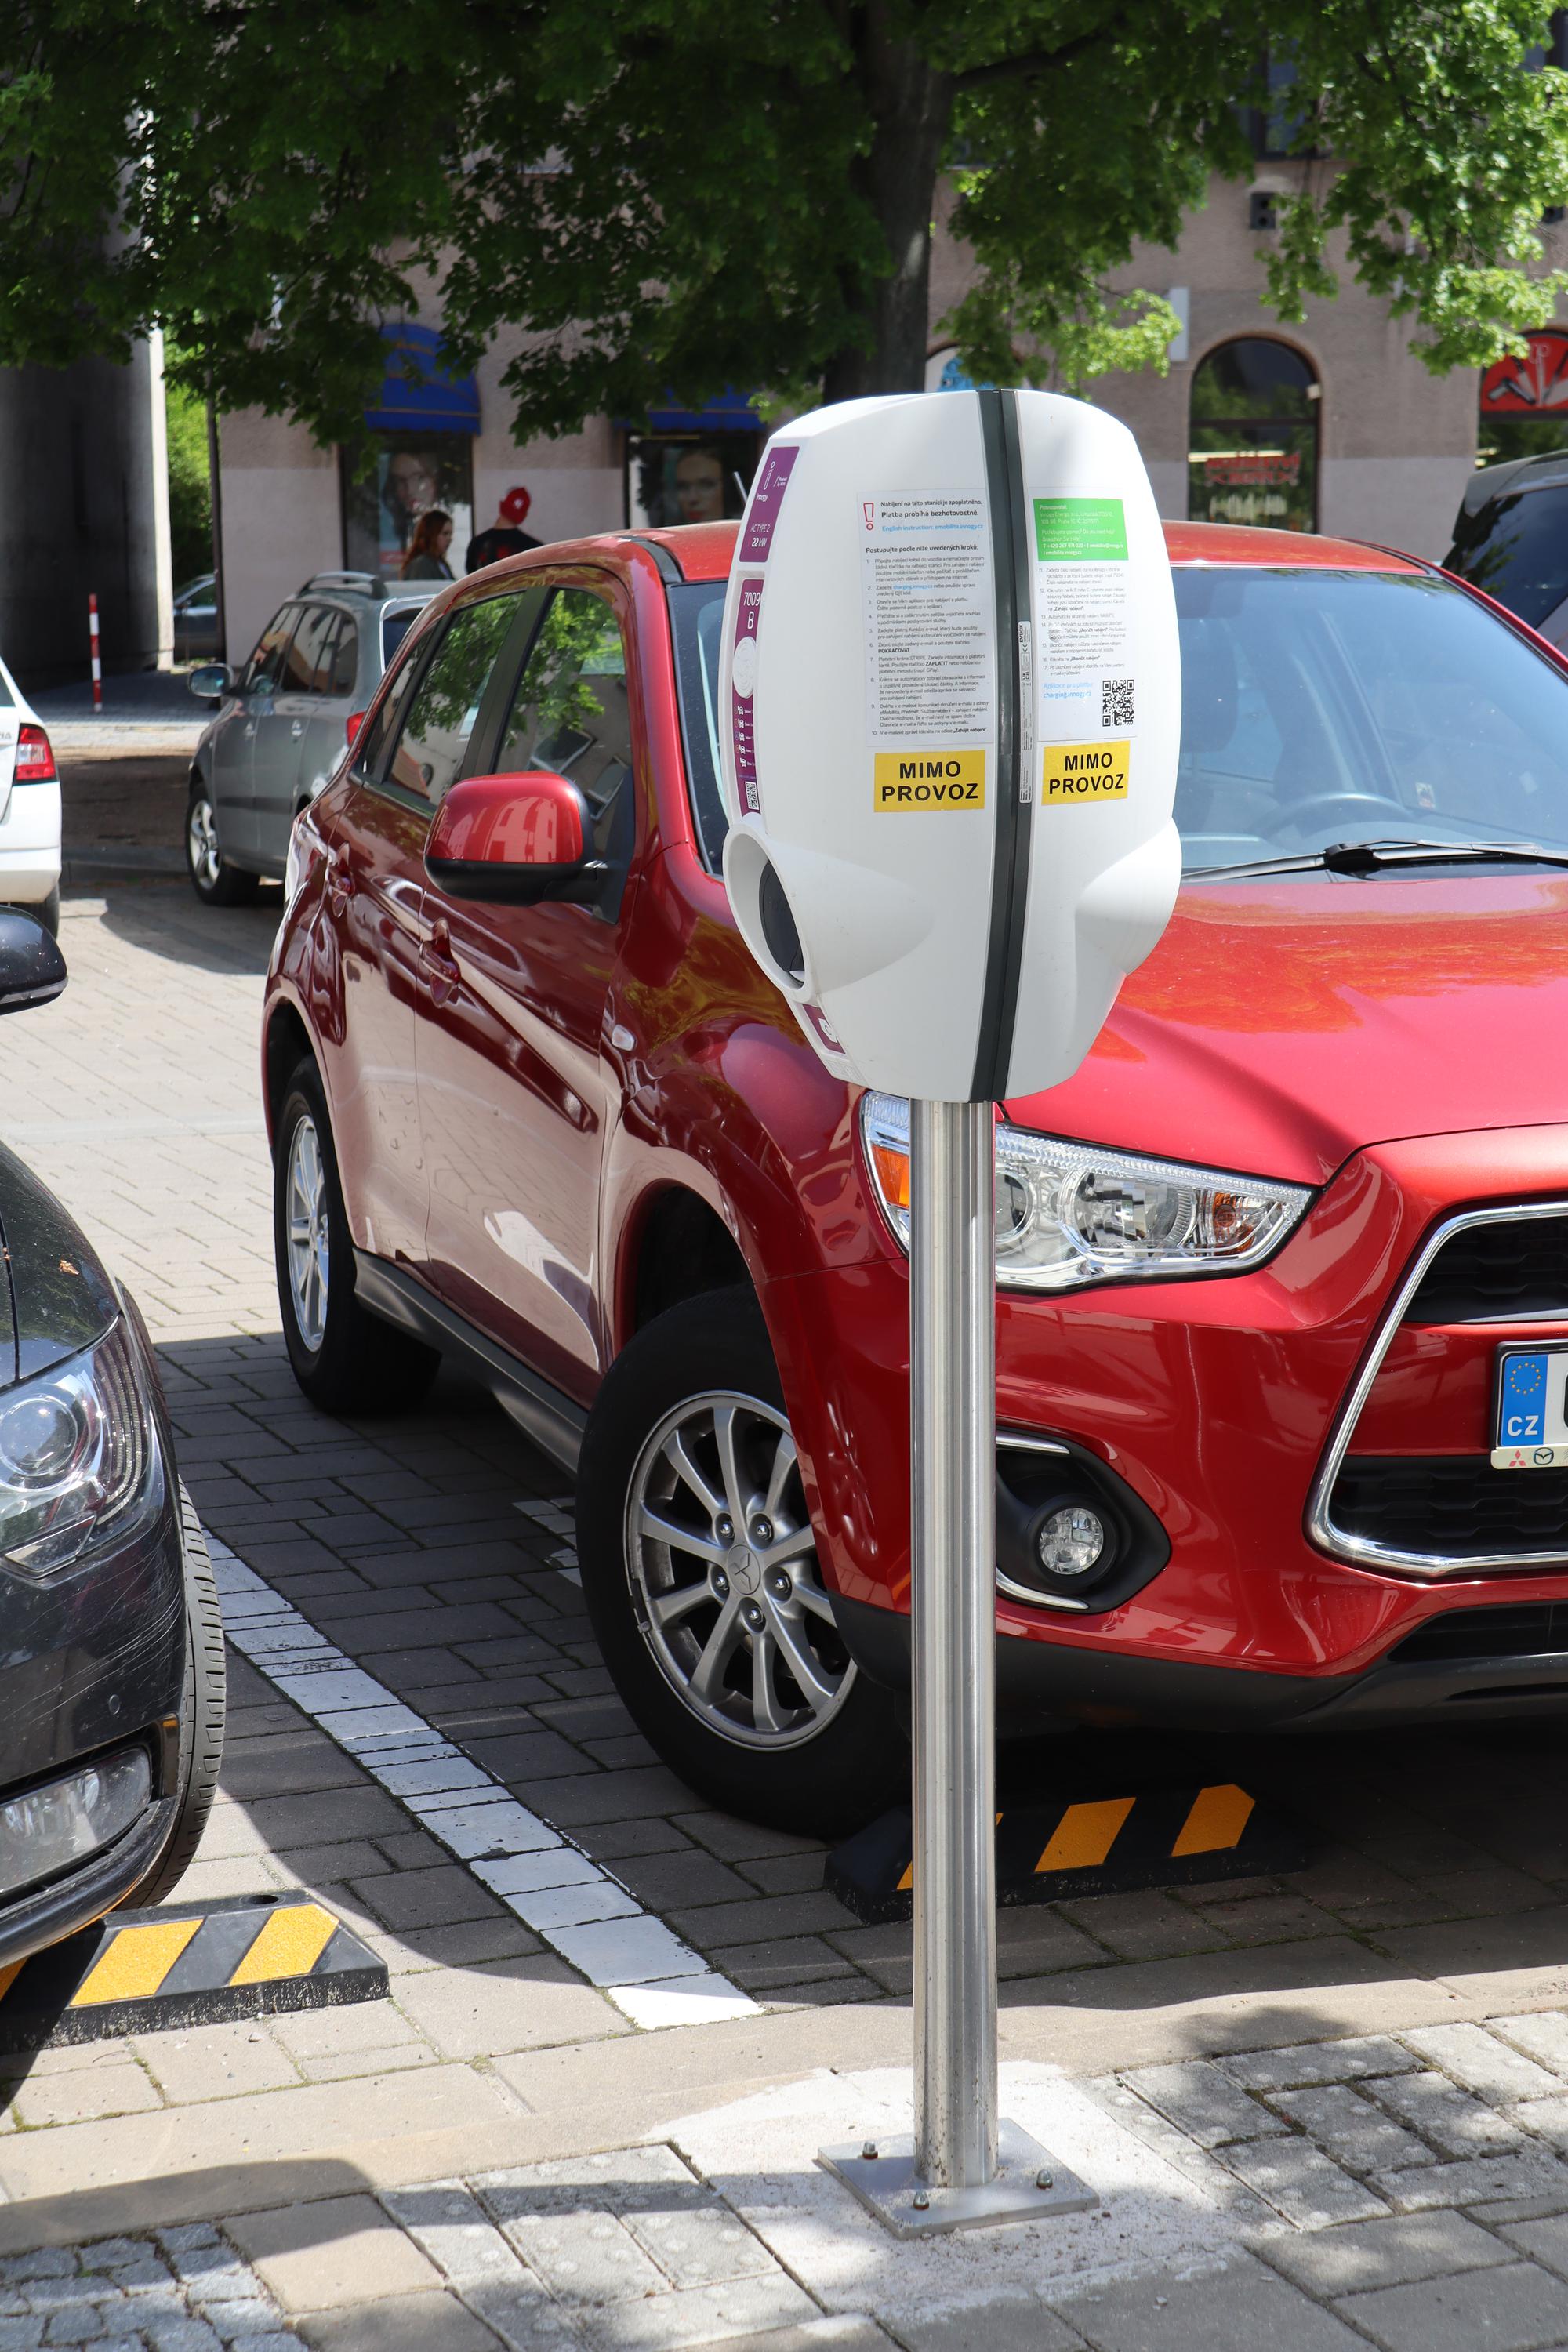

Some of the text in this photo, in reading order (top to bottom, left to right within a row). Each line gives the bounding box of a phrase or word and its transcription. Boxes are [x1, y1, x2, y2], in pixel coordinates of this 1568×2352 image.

[904, 510, 929, 519] probíhá
[757, 524, 767, 532] TYPE
[752, 538, 767, 547] 22 kW
[866, 545, 898, 554] Postupujte
[929, 544, 960, 552] uvedených
[748, 611, 754, 629] B
[900, 761, 961, 778] MIMO
[1065, 752, 1112, 771] MIMO
[882, 783, 978, 801] PROVOZ
[1049, 774, 1124, 794] PROVOZ
[1508, 1415, 1539, 1436] CZ
